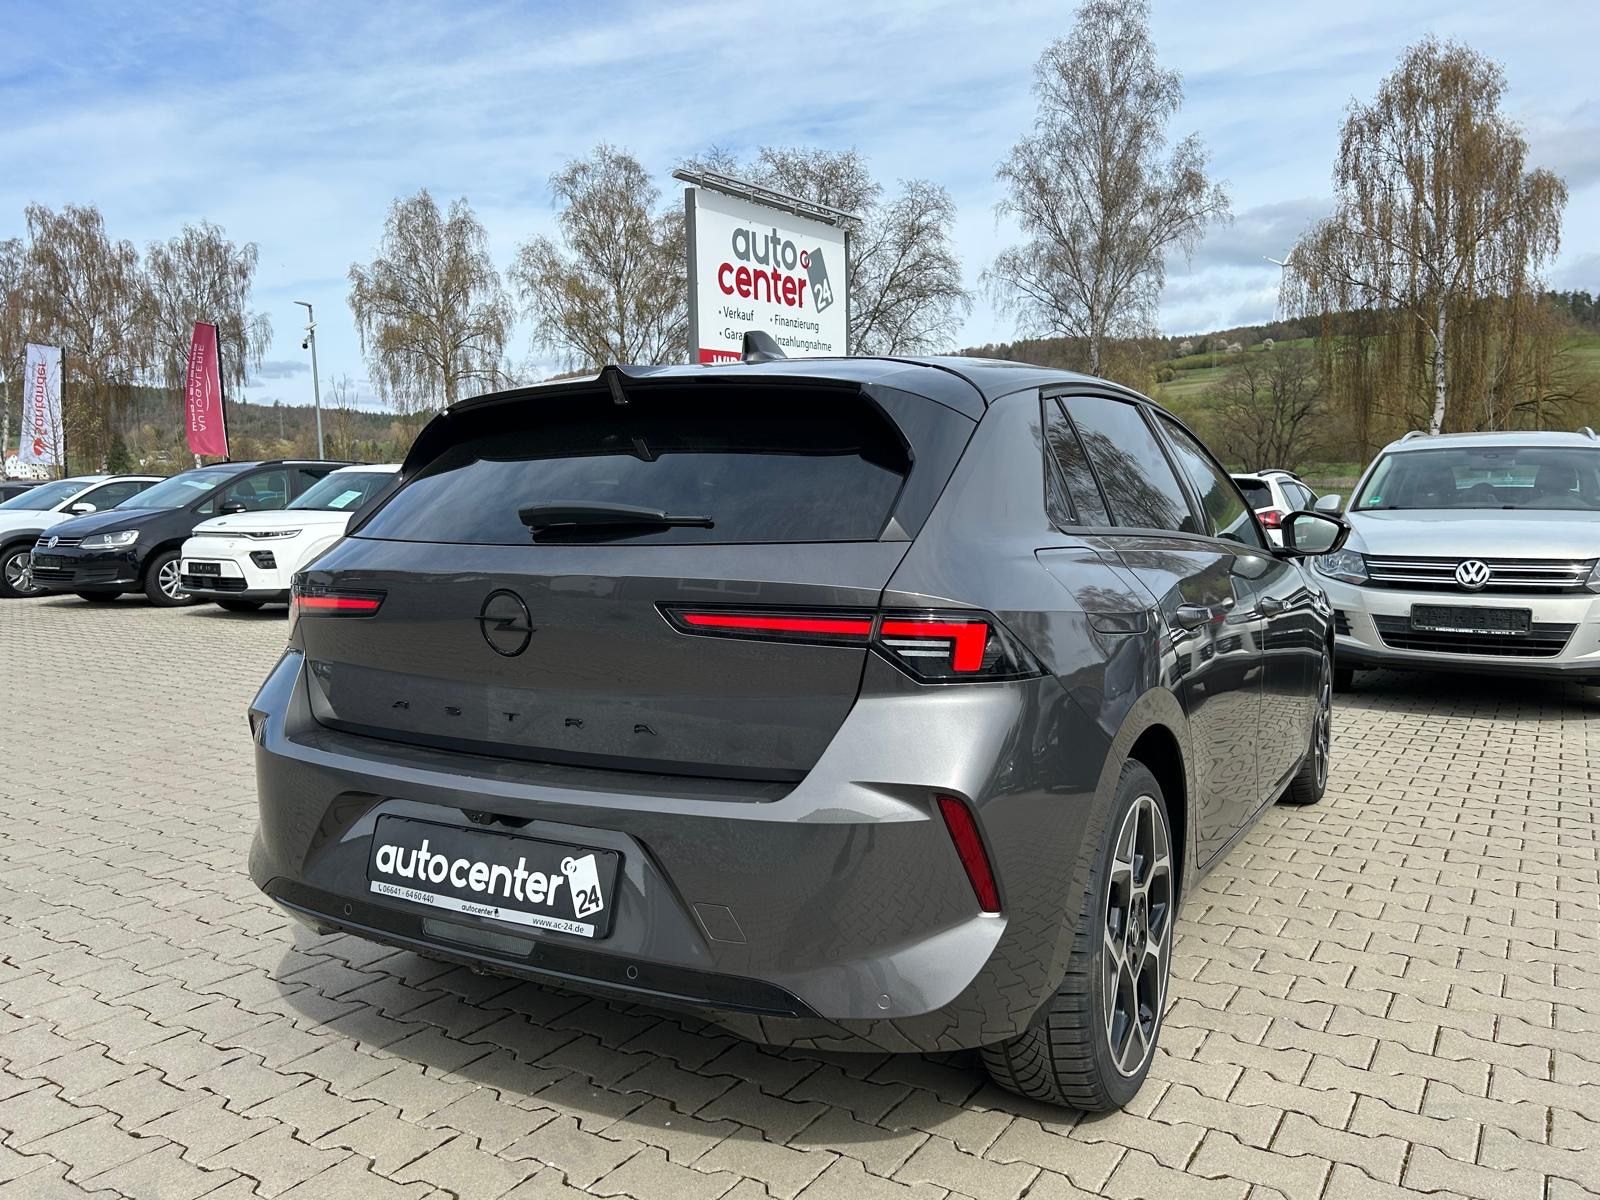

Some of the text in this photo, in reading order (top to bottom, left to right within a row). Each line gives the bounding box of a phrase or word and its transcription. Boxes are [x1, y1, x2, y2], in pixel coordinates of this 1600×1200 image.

[732, 227, 798, 271] auto
[718, 262, 806, 308] center
[813, 278, 832, 307] 24
[723, 305, 754, 321] Verkauf
[724, 327, 743, 341] Gara
[774, 314, 820, 334] Finanzierung
[375, 839, 564, 906] autocenter
[382, 884, 401, 896] 06641
[575, 884, 600, 914] 24
[461, 904, 493, 916] autocenter
[532, 917, 585, 934] www.ac-24.de
